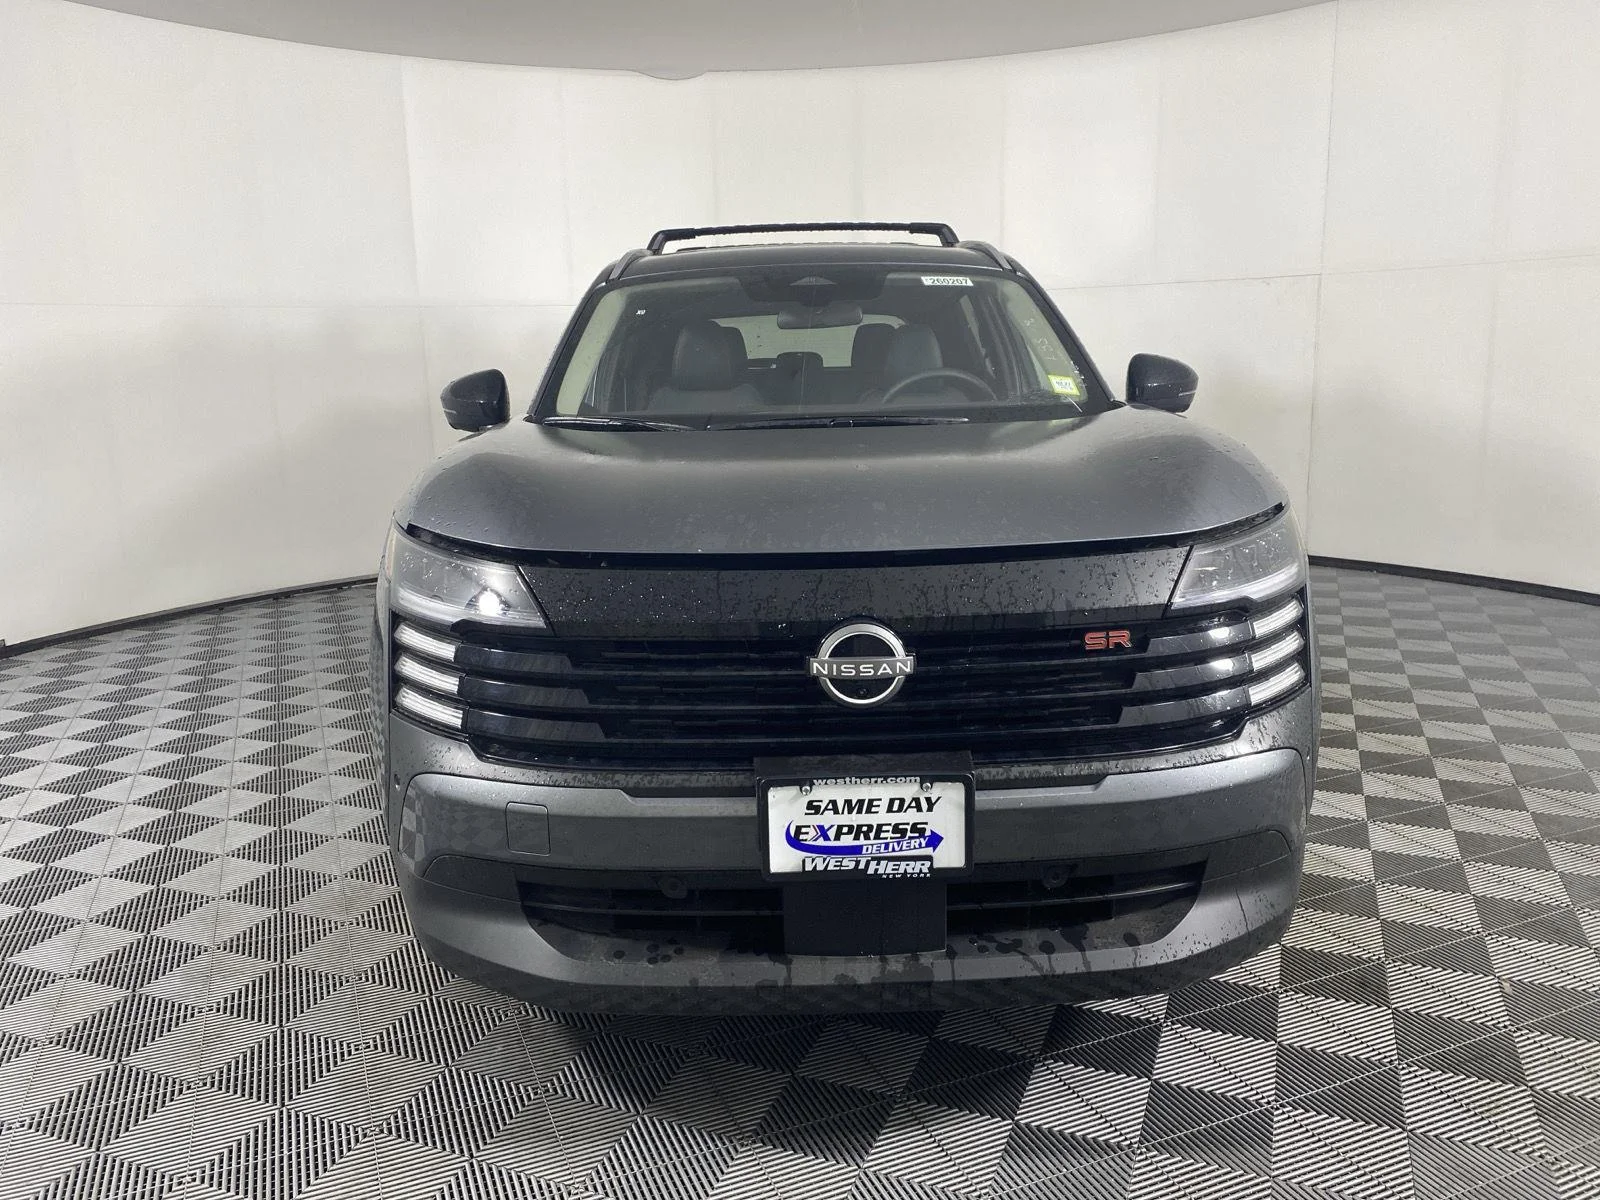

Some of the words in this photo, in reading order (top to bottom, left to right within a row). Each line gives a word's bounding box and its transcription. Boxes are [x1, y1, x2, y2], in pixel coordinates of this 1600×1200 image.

[1084, 630, 1132, 650] SR
[812, 660, 911, 676] NISSAN
[812, 776, 921, 786] westherr.com
[804, 798, 882, 816] SAME
[885, 796, 942, 814] DAY
[793, 821, 929, 842] EXPRESS
[861, 837, 929, 855] DELIVERY
